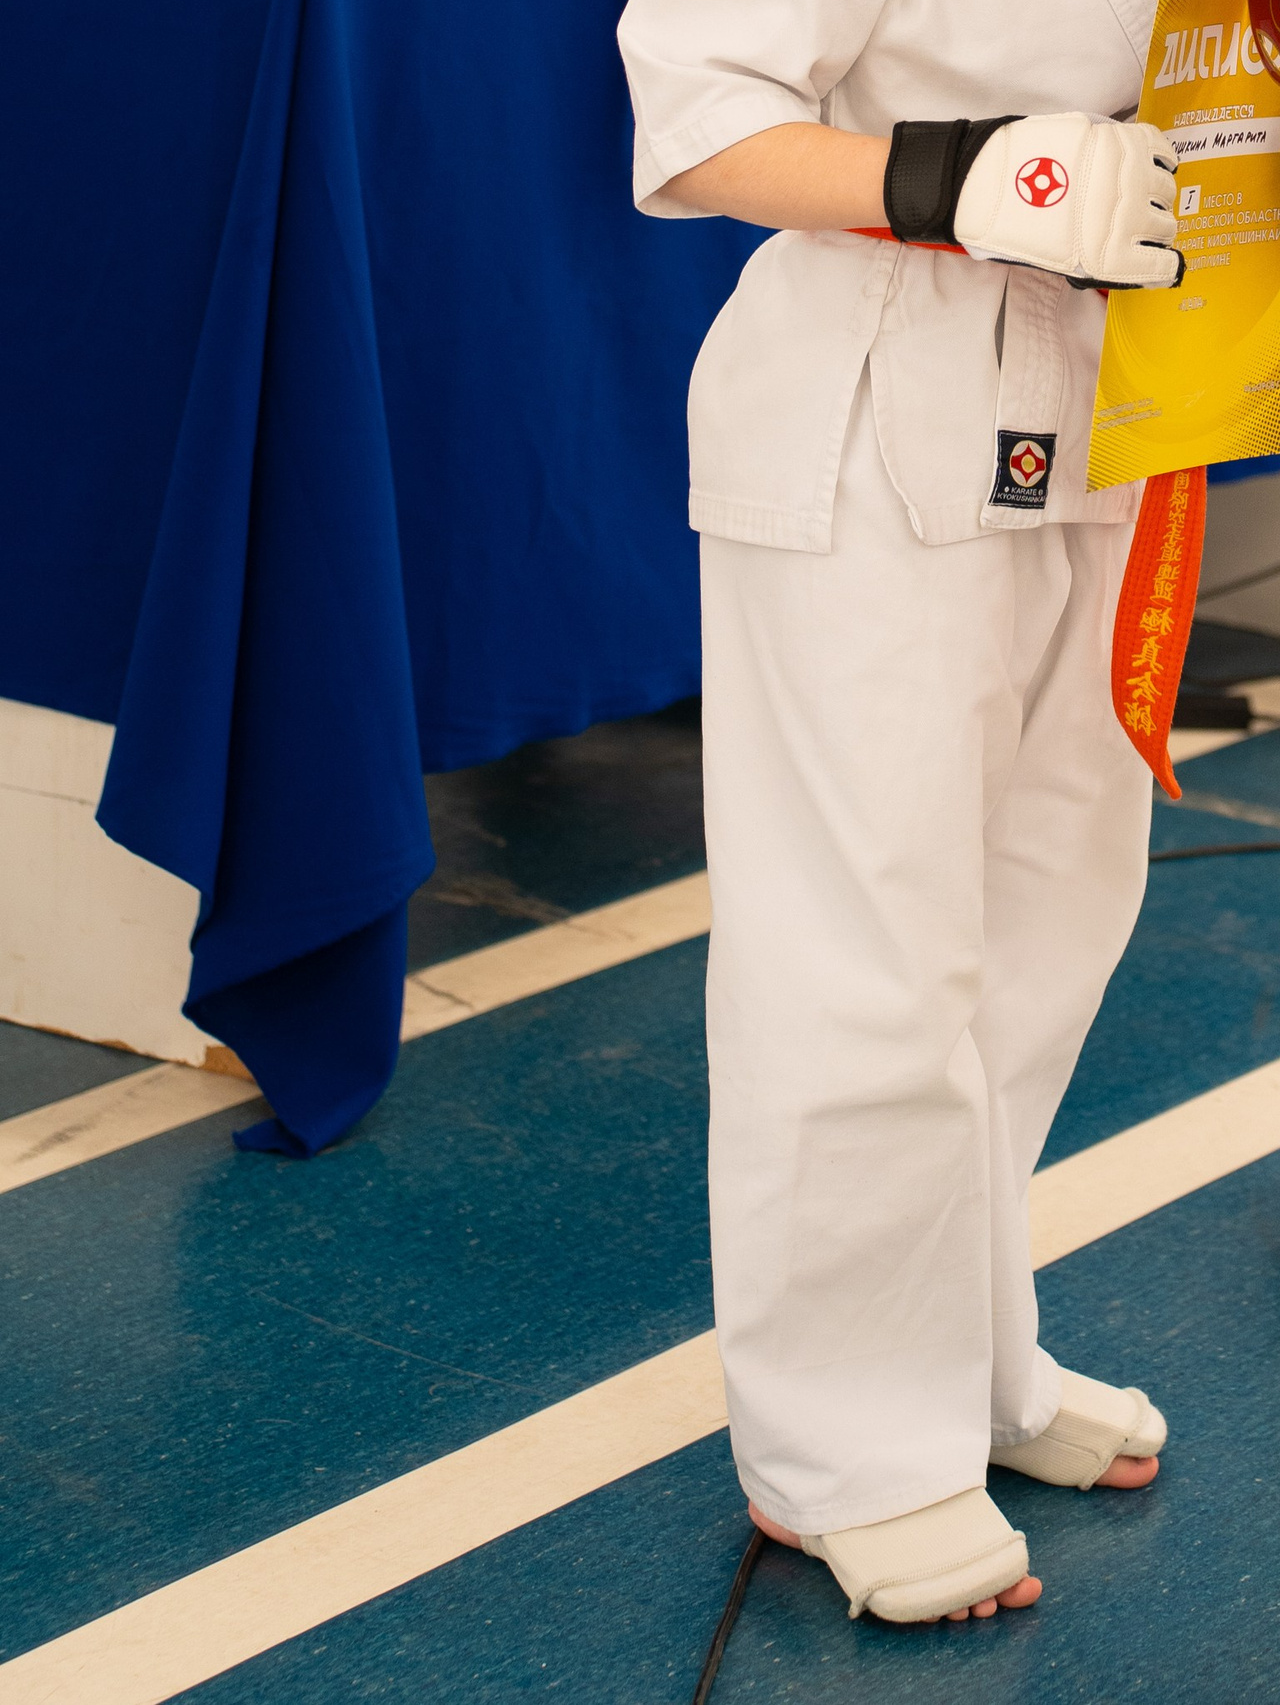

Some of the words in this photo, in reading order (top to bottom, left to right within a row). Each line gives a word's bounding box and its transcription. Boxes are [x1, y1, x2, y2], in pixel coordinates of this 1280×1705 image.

[1173, 104, 1255, 127] НАГРАЖДАЕТСЯ
[1203, 192, 1235, 209] МЕСТО
[1236, 192, 1243, 205] В
[1176, 208, 1234, 234] ЕРДЛОВСКОЙ
[1184, 252, 1231, 272] ЦИПЛИНЕ
[1010, 486, 1037, 495] KARATE
